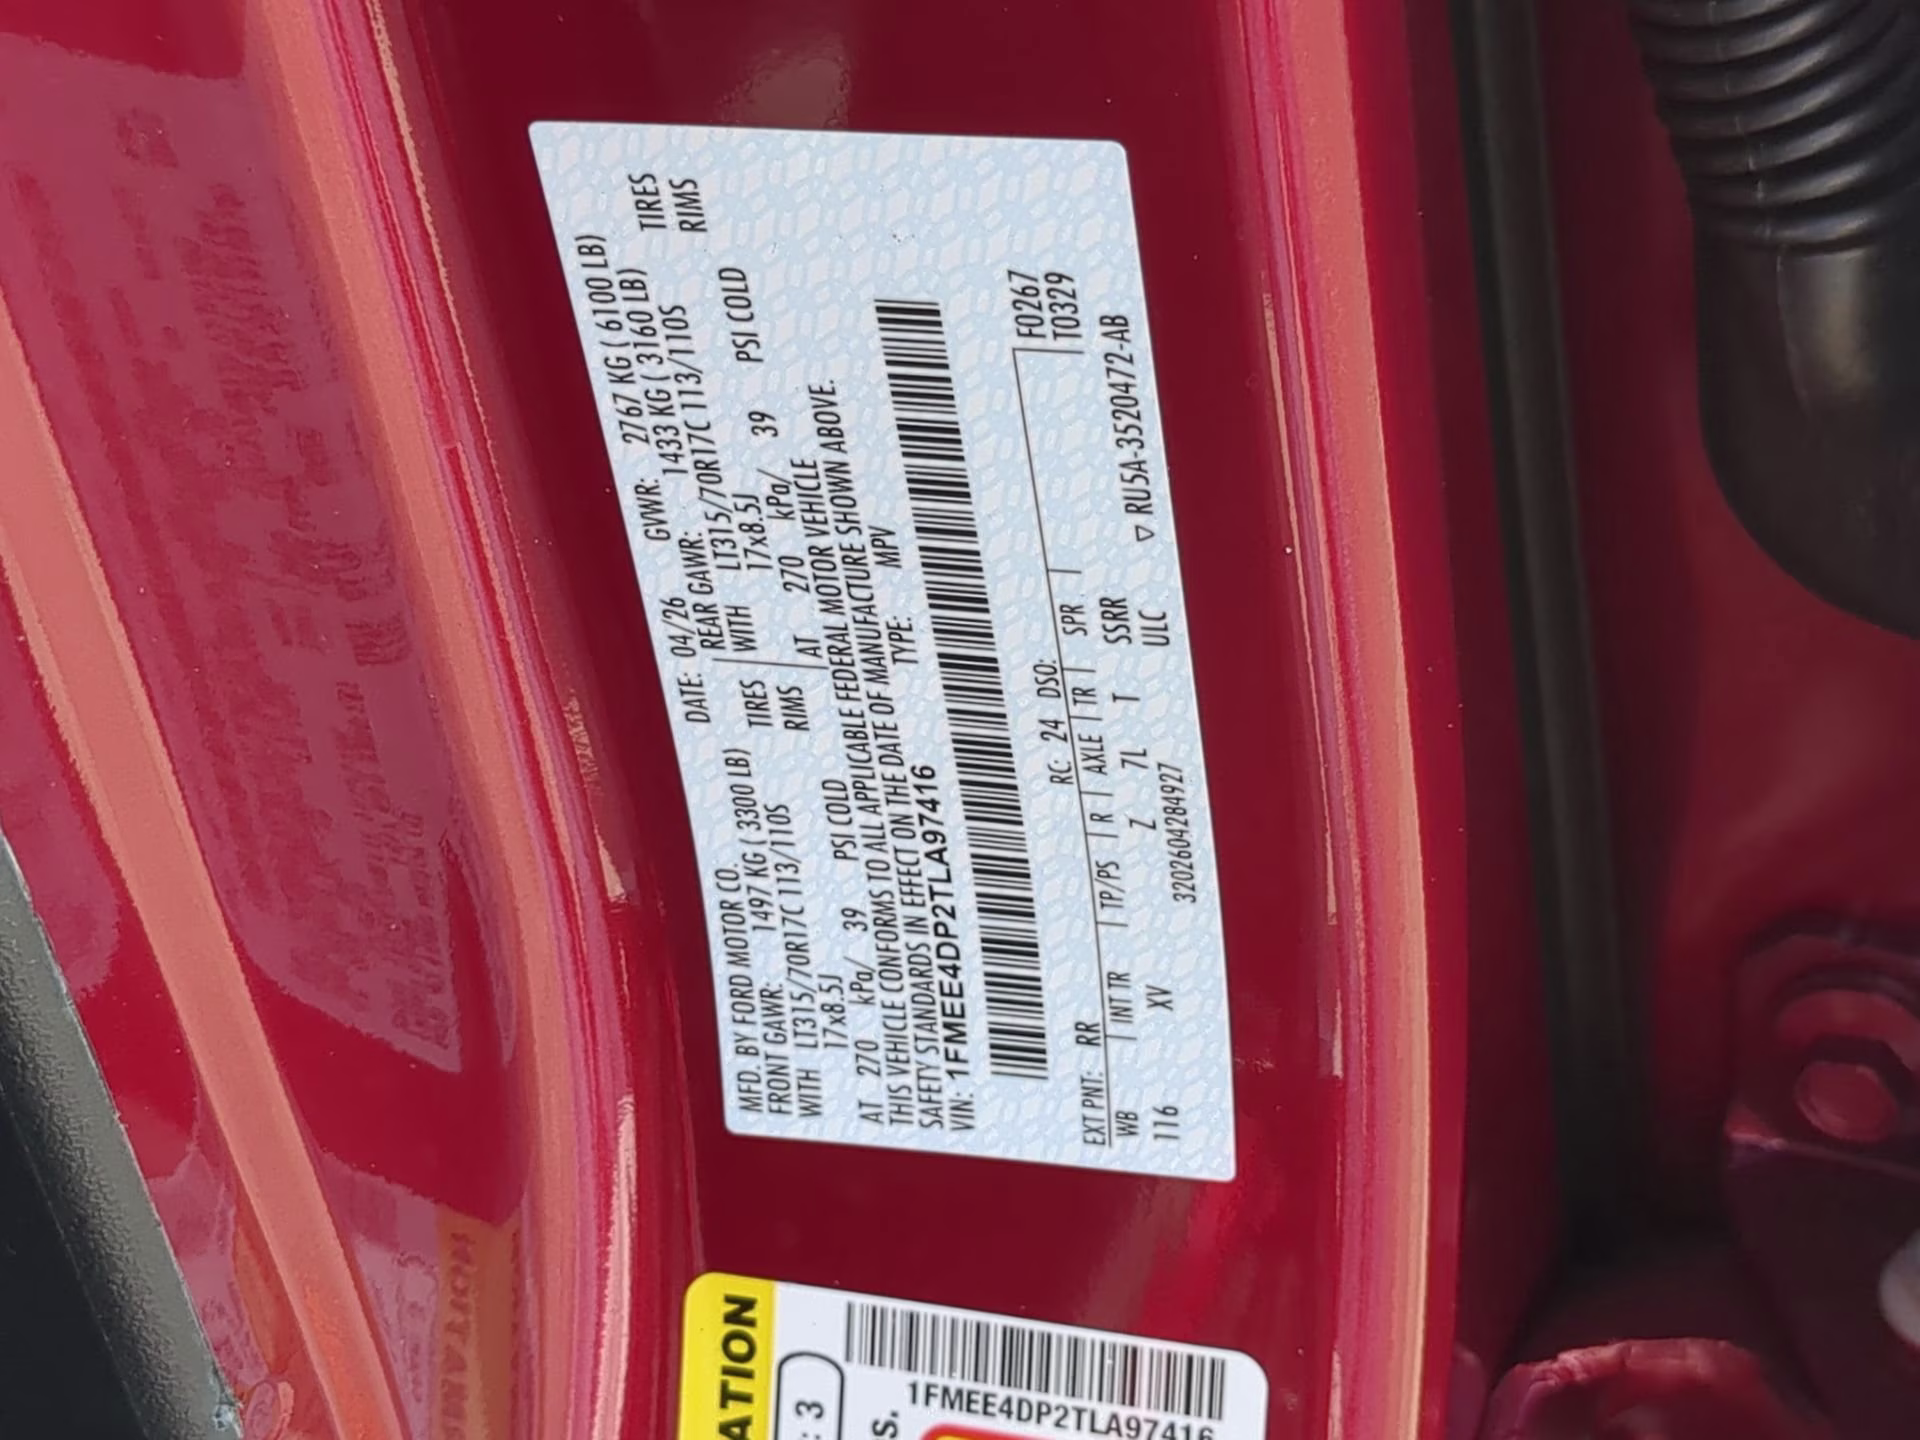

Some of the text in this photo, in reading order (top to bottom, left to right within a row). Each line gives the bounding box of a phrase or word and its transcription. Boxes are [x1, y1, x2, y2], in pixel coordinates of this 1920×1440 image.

[627, 173, 667, 232] TIRES
[668, 178, 708, 233] RIMS
[574, 234, 609, 269] LB)
[584, 276, 624, 332] 6100
[616, 268, 650, 302] LB)
[1007, 269, 1047, 339] F0267
[1043, 272, 1082, 341] T0329
[626, 310, 664, 366] 3160
[603, 356, 636, 384] KG
[612, 392, 650, 445] 2767
[644, 388, 676, 417] KG
[1098, 314, 1154, 515] RU5A-3520472-AB
[652, 424, 689, 475] 1433
[718, 267, 823, 659] AT 270 kPa/ 39 PSI COLD
[657, 304, 758, 652] WITH LT315/70R17C 113/110S
[633, 478, 672, 541] GVWR:
[731, 493, 773, 570] 17x8.5J
[678, 531, 714, 596] GAWR:
[868, 525, 902, 569] MPV
[692, 602, 726, 650] REAR
[885, 616, 919, 665] TYPE:
[1059, 604, 1088, 636] SPR
[1098, 596, 1132, 644] SSRR
[1138, 610, 1170, 647] ULC
[660, 596, 711, 724] DATE: 04/26
[1032, 659, 1062, 699] DSO:
[738, 679, 773, 728] TIRES
[775, 686, 810, 732] RIMS
[1071, 686, 1098, 706] TR
[1111, 692, 1140, 703] T
[722, 748, 752, 778] LB)
[807, 380, 944, 1128] SAFETY STANDARDS IN EFFECT ON THE DATE OF MANUFACTURE SHOWN ABOVE.
[1038, 719, 1074, 785] RC: 24
[1078, 734, 1108, 776] AXLE
[1120, 748, 1148, 769] 7L
[729, 783, 762, 831] 3300
[790, 458, 913, 1125] THIS VEHICLE CONFORMS TO ALL APPLICABLE FEDERAL MOTOR VEHICLE
[1089, 812, 1114, 823] R
[1128, 818, 1157, 830] Z
[1157, 762, 1197, 904] 3202604284927
[741, 852, 769, 878] KG
[1094, 860, 1124, 910] TP/PS
[746, 884, 776, 931] 1497
[763, 804, 822, 1117] WITH LT315/70R17C 113/110S
[821, 779, 882, 1124] AT 270 kPa/ 39 PSI COLD
[910, 765, 974, 1131] VIN: 1FMEE4DP2TLA97416
[714, 862, 762, 1113] MFD. BY FORD MOTOR CO.
[818, 974, 848, 1048] 17x8.5J
[1106, 971, 1132, 1024] INT TR
[1146, 985, 1173, 1011] XV
[759, 983, 788, 1045] GAWR:
[764, 1052, 791, 1115] FRONT
[1074, 1021, 1106, 1146] EXT PNT: RR
[1115, 1110, 1138, 1136] WB
[1153, 1106, 1179, 1140] 116
[794, 1400, 825, 1420] 3
[908, 1381, 1215, 1440] 1FMEE4DP2TLA97416
